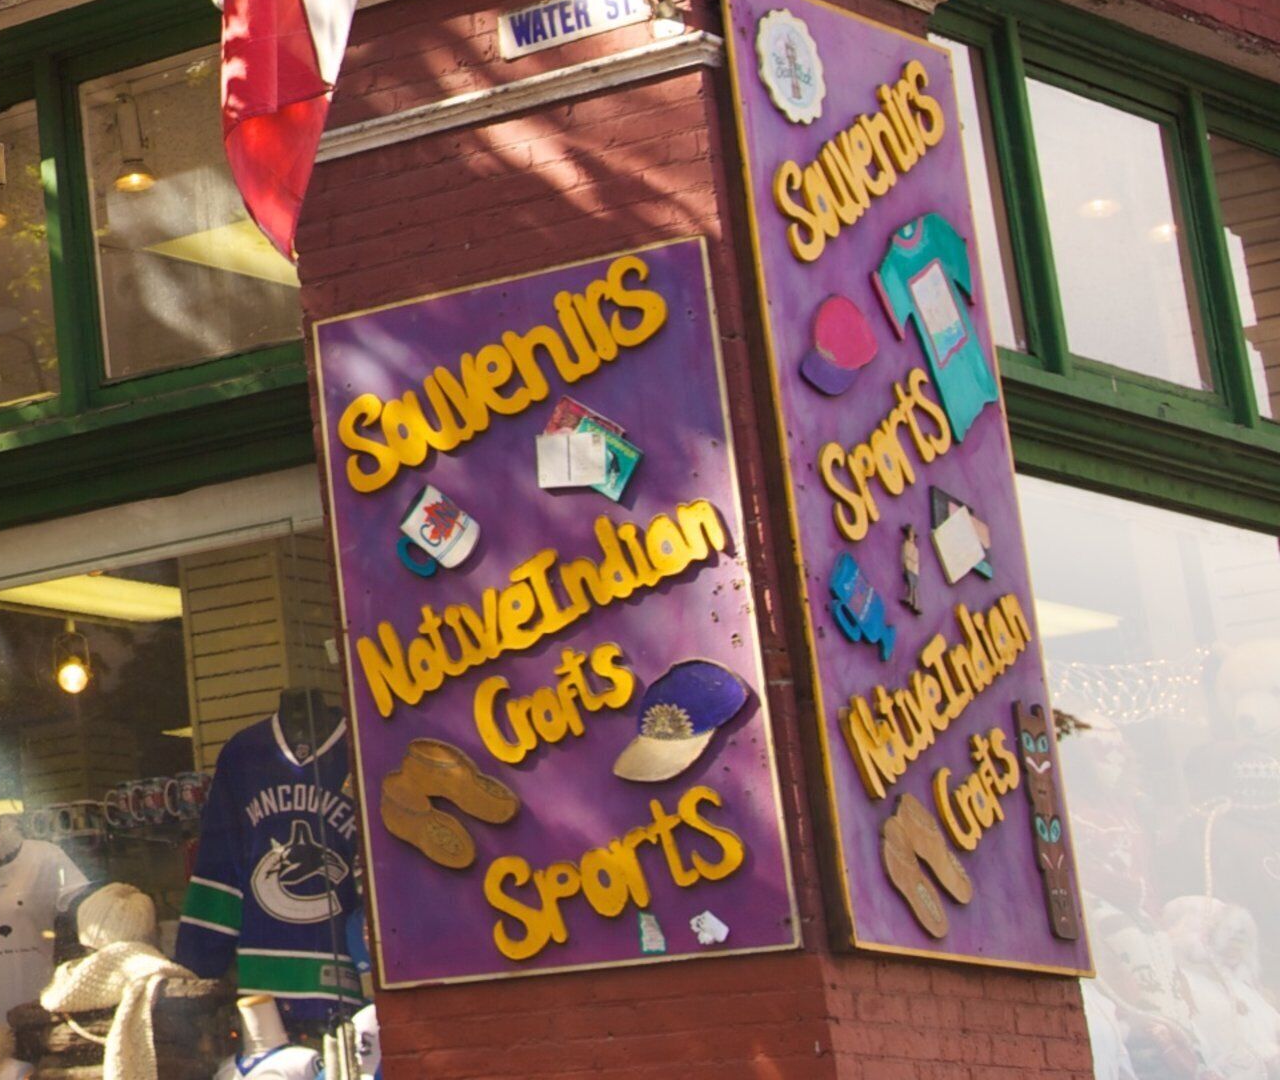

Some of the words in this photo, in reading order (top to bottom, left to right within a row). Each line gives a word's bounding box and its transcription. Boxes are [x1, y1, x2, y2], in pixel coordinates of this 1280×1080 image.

[773, 59, 946, 263] Souvenirs
[338, 255, 669, 494] Souvenirs
[818, 366, 952, 542] Sports
[472, 641, 638, 765] Crafts
[933, 727, 1021, 851] Crafts
[244, 782, 358, 841] VANCOUVER
[482, 785, 744, 962] Sports
